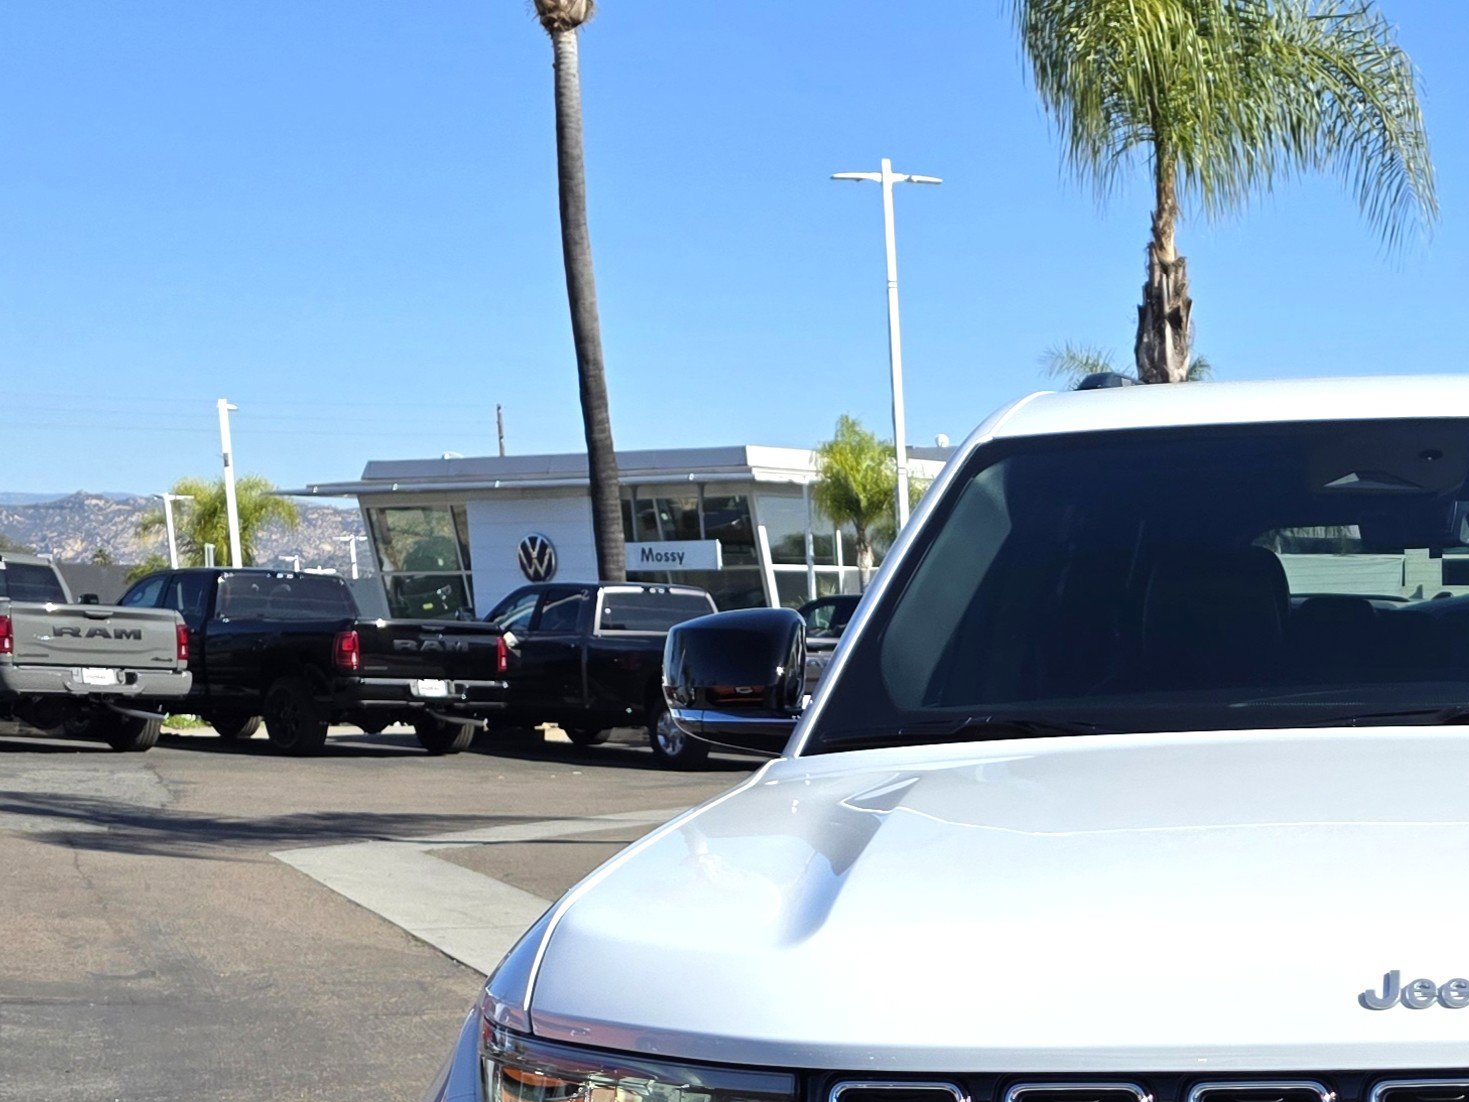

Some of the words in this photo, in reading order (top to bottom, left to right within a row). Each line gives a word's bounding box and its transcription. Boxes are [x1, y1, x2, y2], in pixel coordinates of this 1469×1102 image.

[640, 547, 685, 565] Mossy
[52, 626, 142, 641] RAM
[393, 639, 469, 653] RAM
